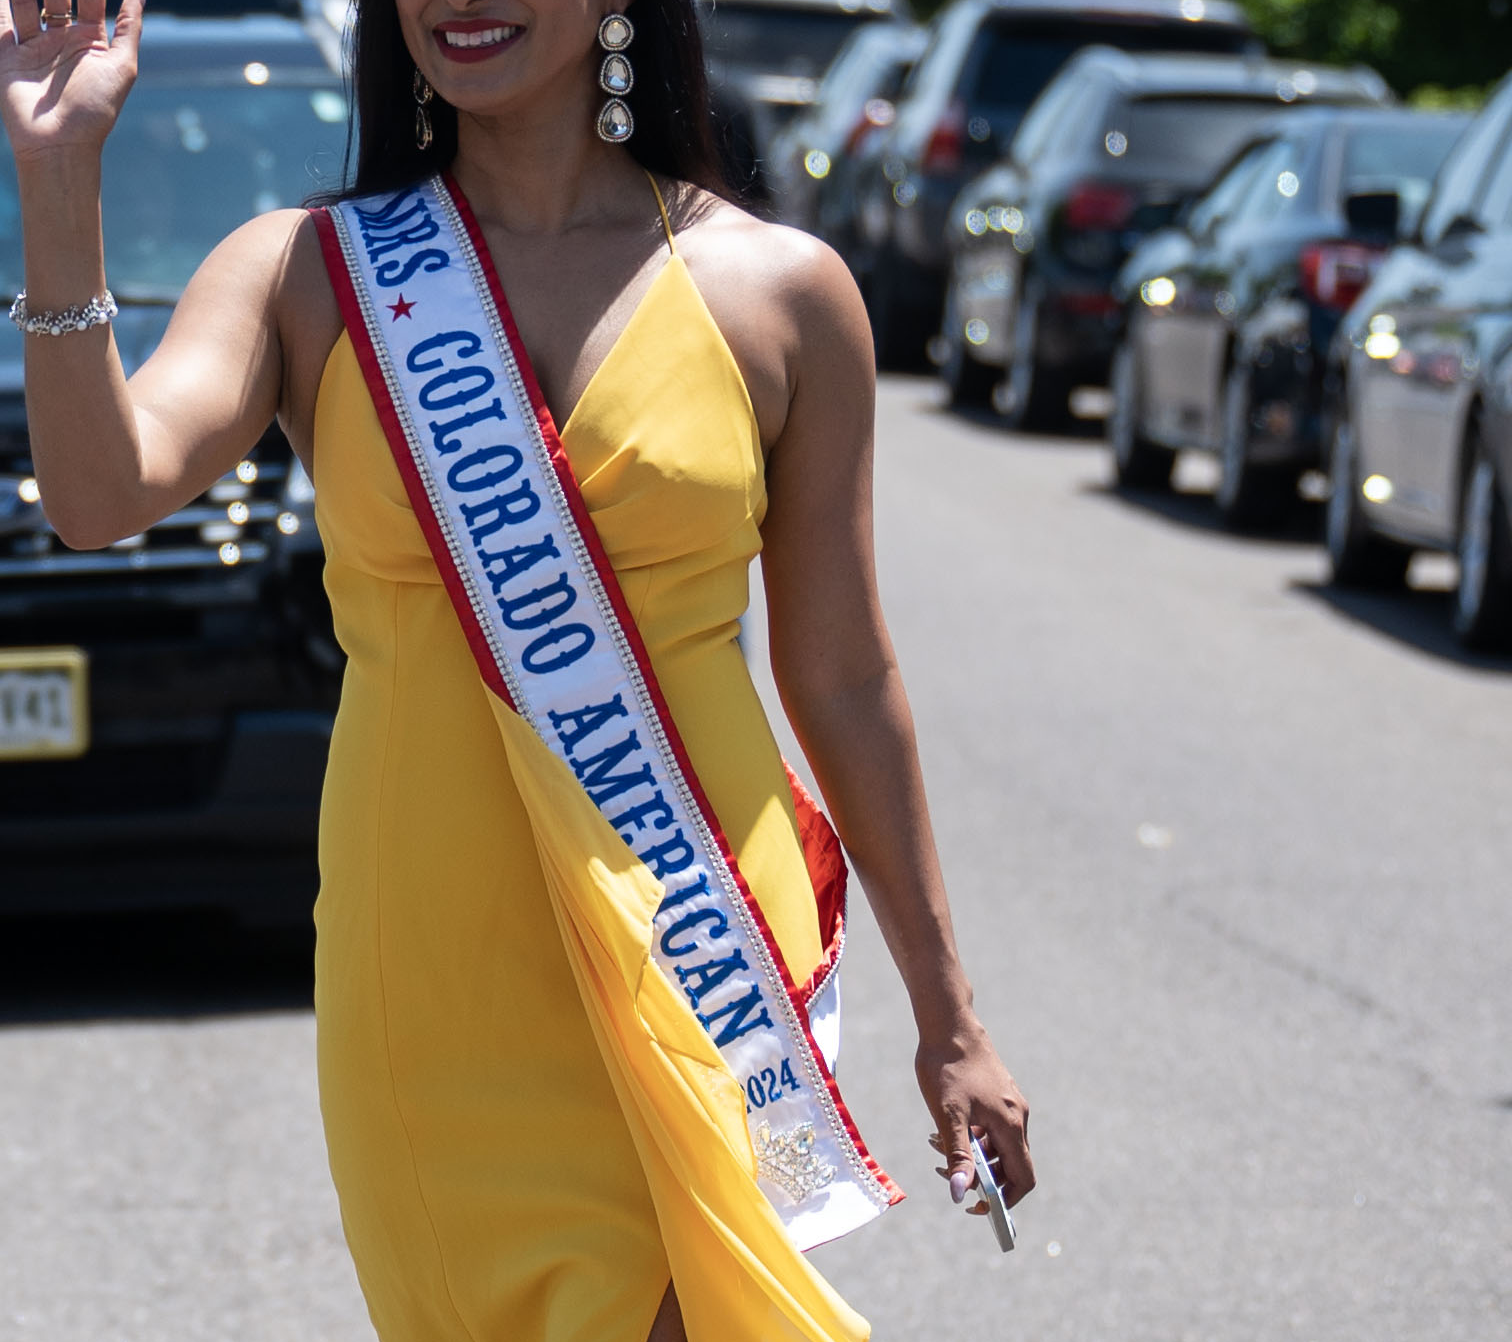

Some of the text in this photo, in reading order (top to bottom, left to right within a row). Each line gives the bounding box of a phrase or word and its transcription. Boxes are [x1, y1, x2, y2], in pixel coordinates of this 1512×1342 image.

[353, 186, 775, 1049] MRS COLORADO AMERICAN
[739, 1057, 800, 1114] 024
